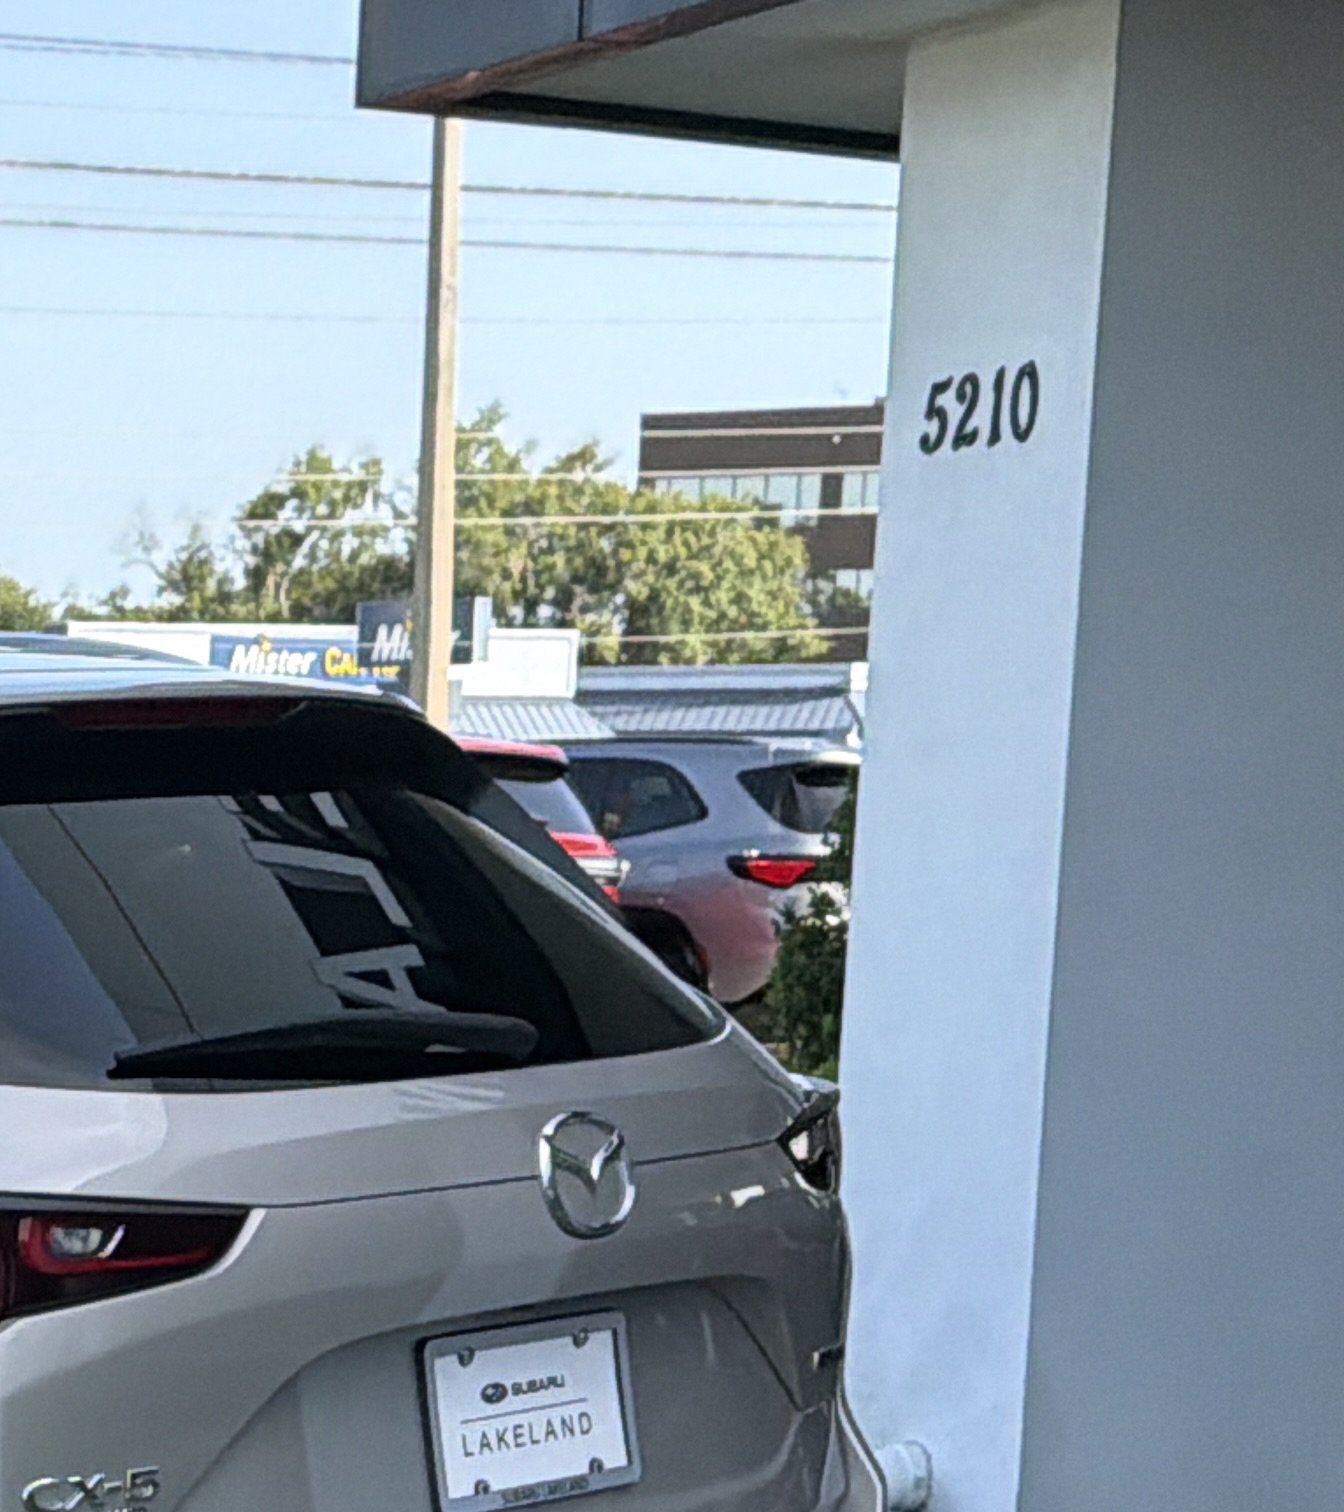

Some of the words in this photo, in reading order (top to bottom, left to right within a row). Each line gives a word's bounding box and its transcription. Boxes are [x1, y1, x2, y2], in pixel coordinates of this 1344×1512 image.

[919, 359, 1039, 456] 5210
[230, 638, 316, 676] Mister
[511, 1374, 566, 1397] SUBARU
[462, 1411, 593, 1458] LAKELAND
